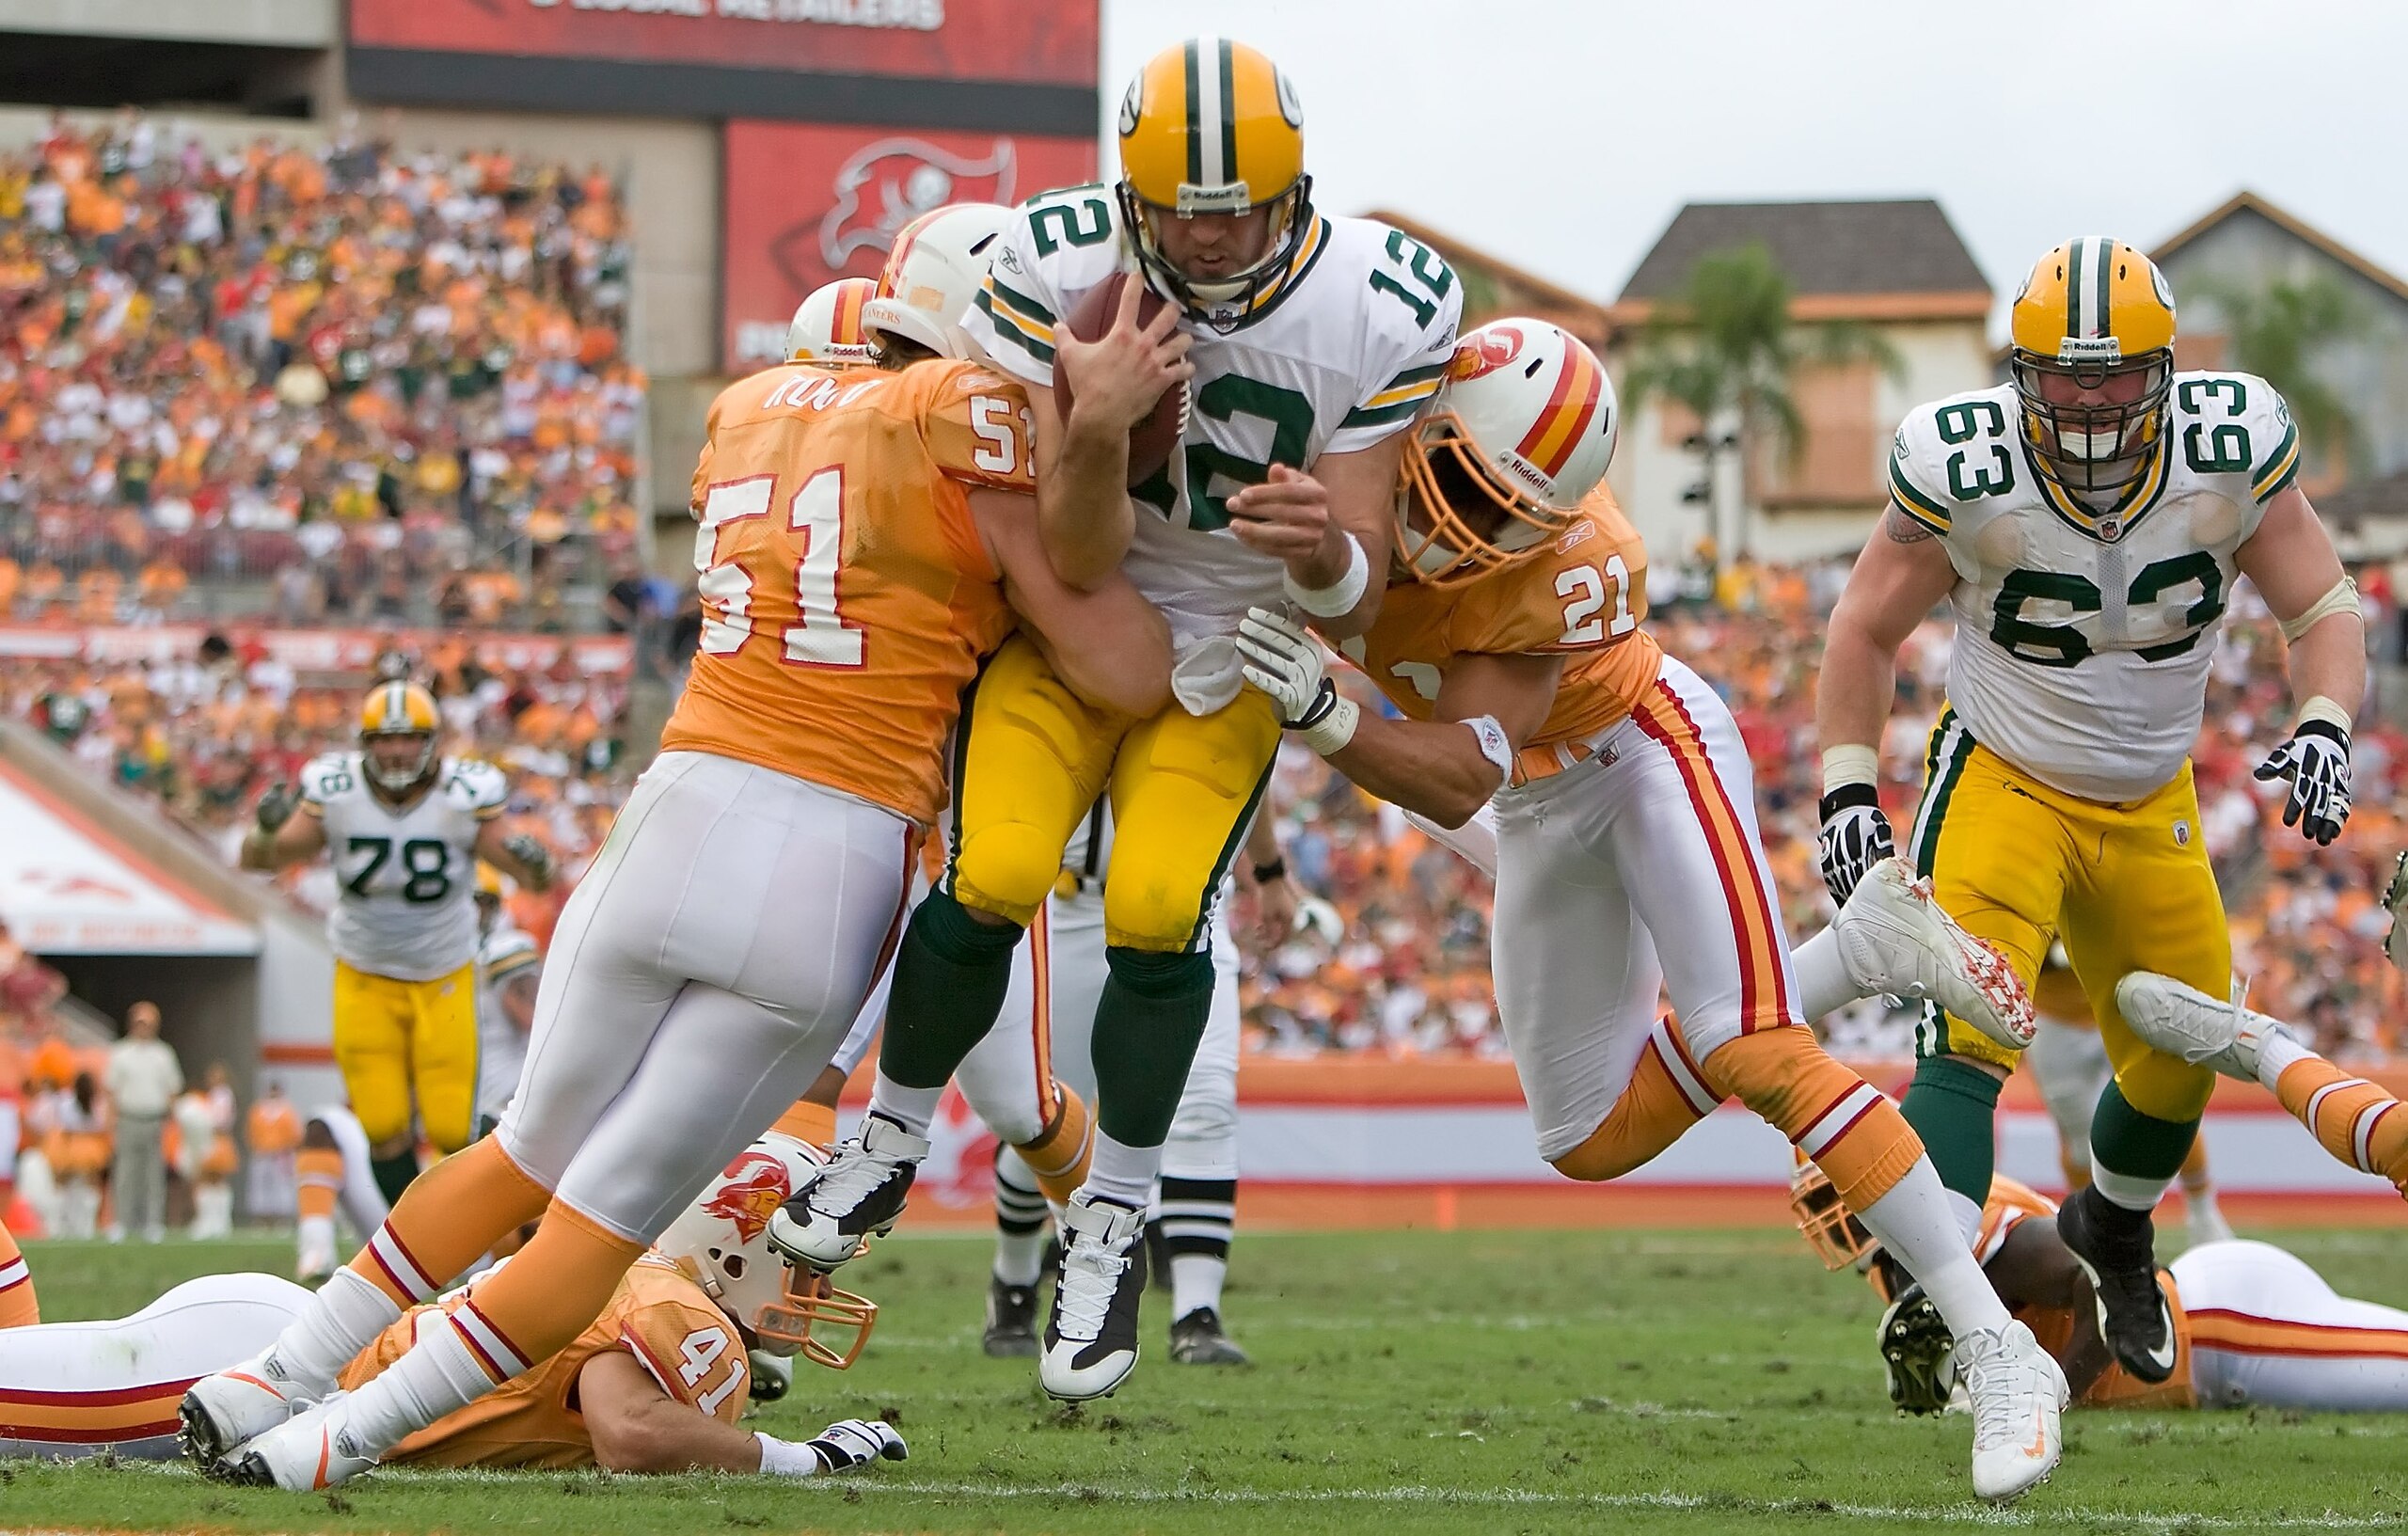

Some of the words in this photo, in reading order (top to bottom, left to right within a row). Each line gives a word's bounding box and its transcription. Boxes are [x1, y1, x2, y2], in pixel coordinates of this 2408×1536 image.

[1369, 230, 1453, 332] 12
[833, 347, 863, 356] Riddell
[2073, 342, 2107, 351] Riddell
[1128, 372, 1315, 530] 2
[1935, 401, 2016, 501] 63
[2178, 379, 2253, 473] 63
[1511, 458, 1548, 490] Riddell
[693, 464, 868, 670] 51
[1553, 553, 1636, 644] 21
[1989, 551, 2226, 669] 63
[348, 837, 450, 903] 78
[676, 1325, 748, 1417] 41
